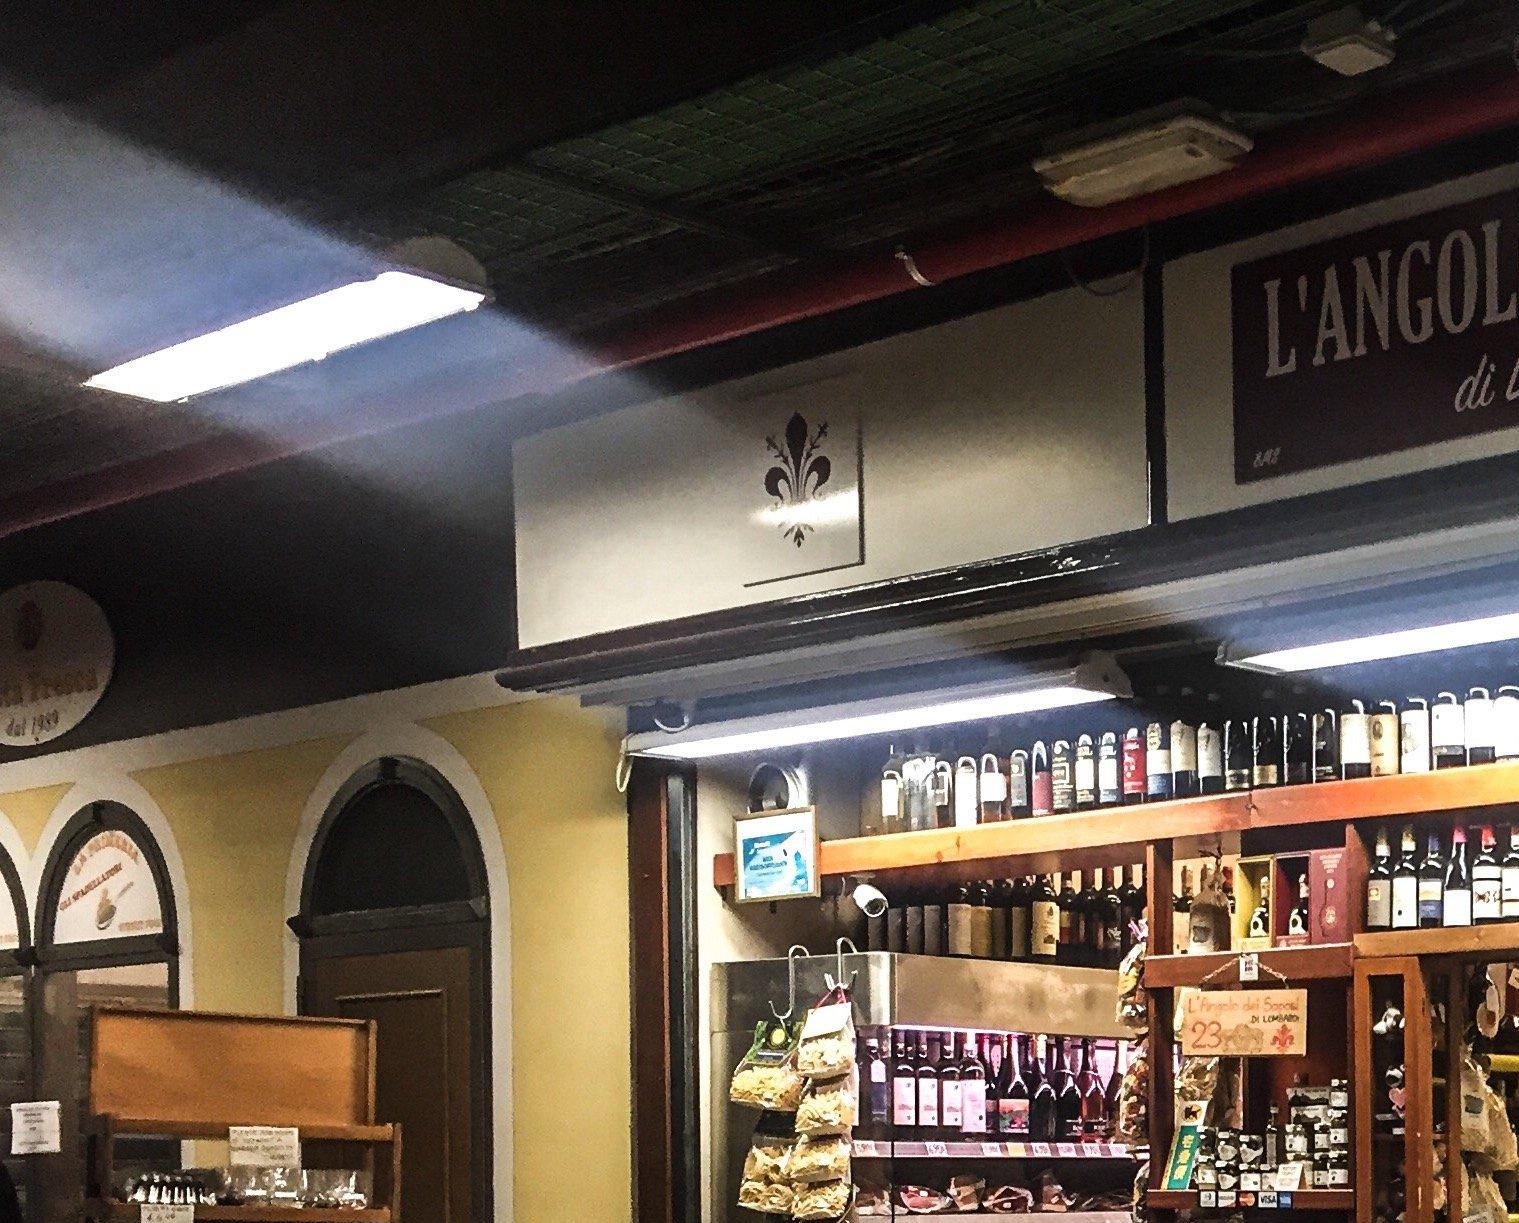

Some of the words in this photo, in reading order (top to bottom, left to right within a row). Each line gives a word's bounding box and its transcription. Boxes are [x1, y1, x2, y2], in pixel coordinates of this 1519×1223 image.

[1454, 353, 1497, 414] di
[1242, 995, 1260, 1011] dei
[1250, 1014, 1260, 1023] DI
[1191, 1020, 1223, 1049] 23
[1260, 1194, 1277, 1204] VISA
